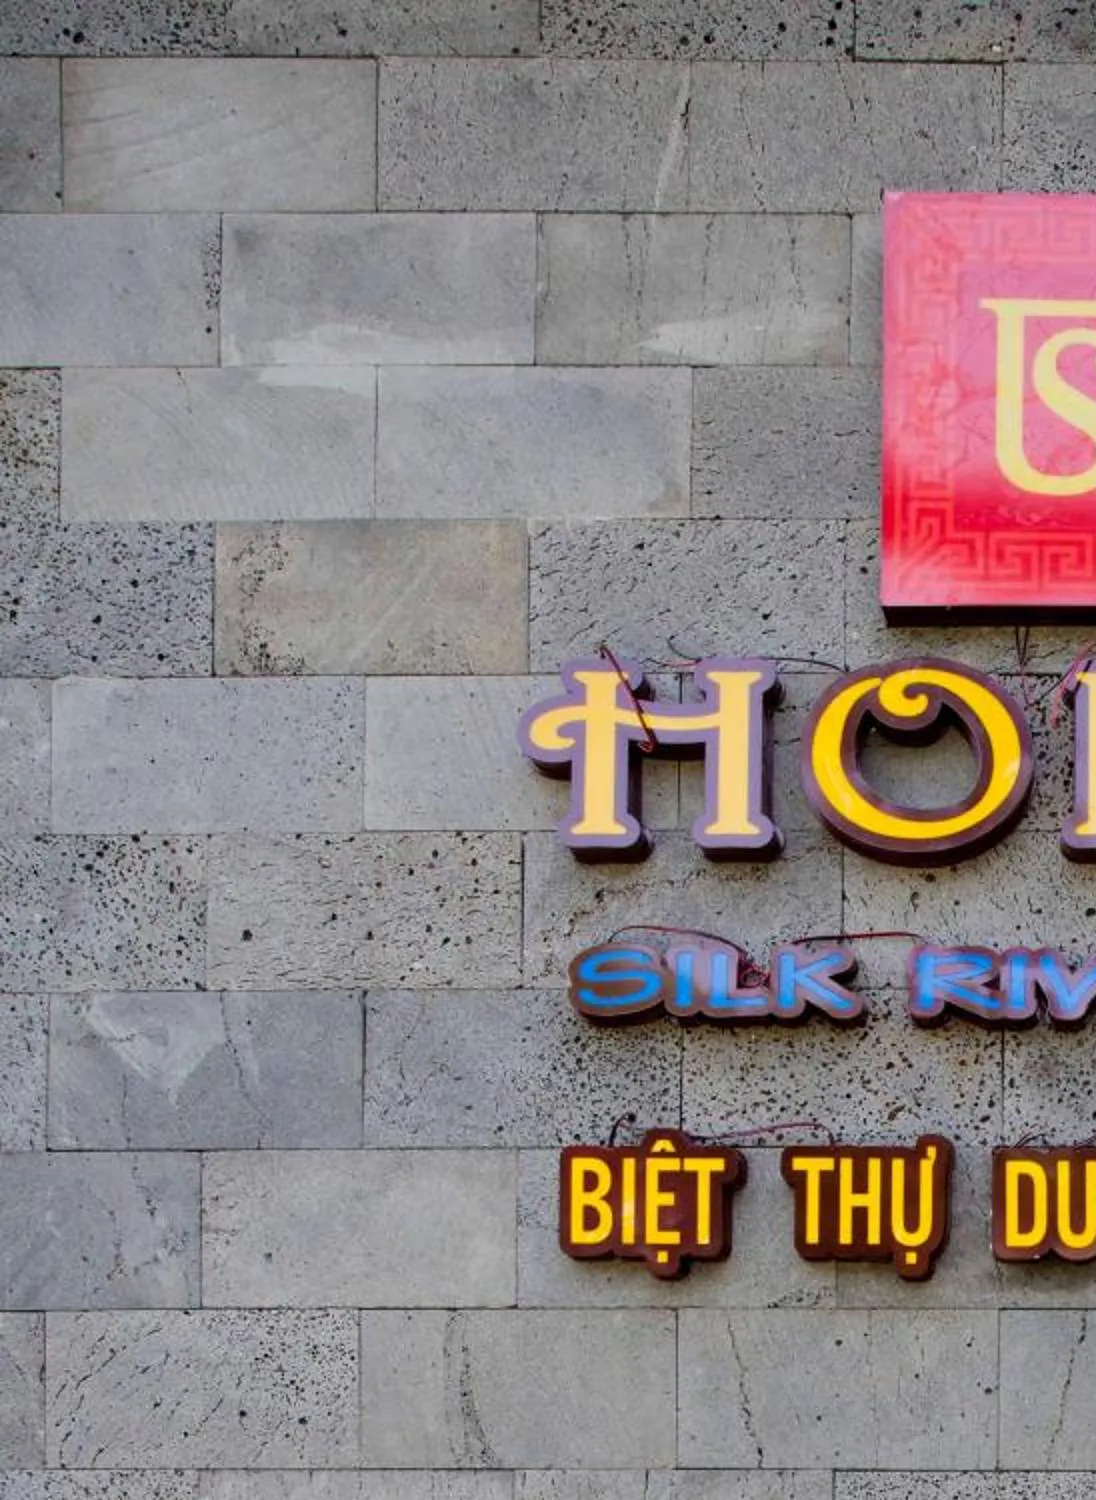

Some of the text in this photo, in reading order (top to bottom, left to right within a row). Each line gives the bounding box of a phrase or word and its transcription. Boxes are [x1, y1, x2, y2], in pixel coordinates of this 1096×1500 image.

[574, 948, 863, 1011] SILK
[568, 1138, 726, 1265] BIỆT
[791, 1143, 938, 1266] THỰ
